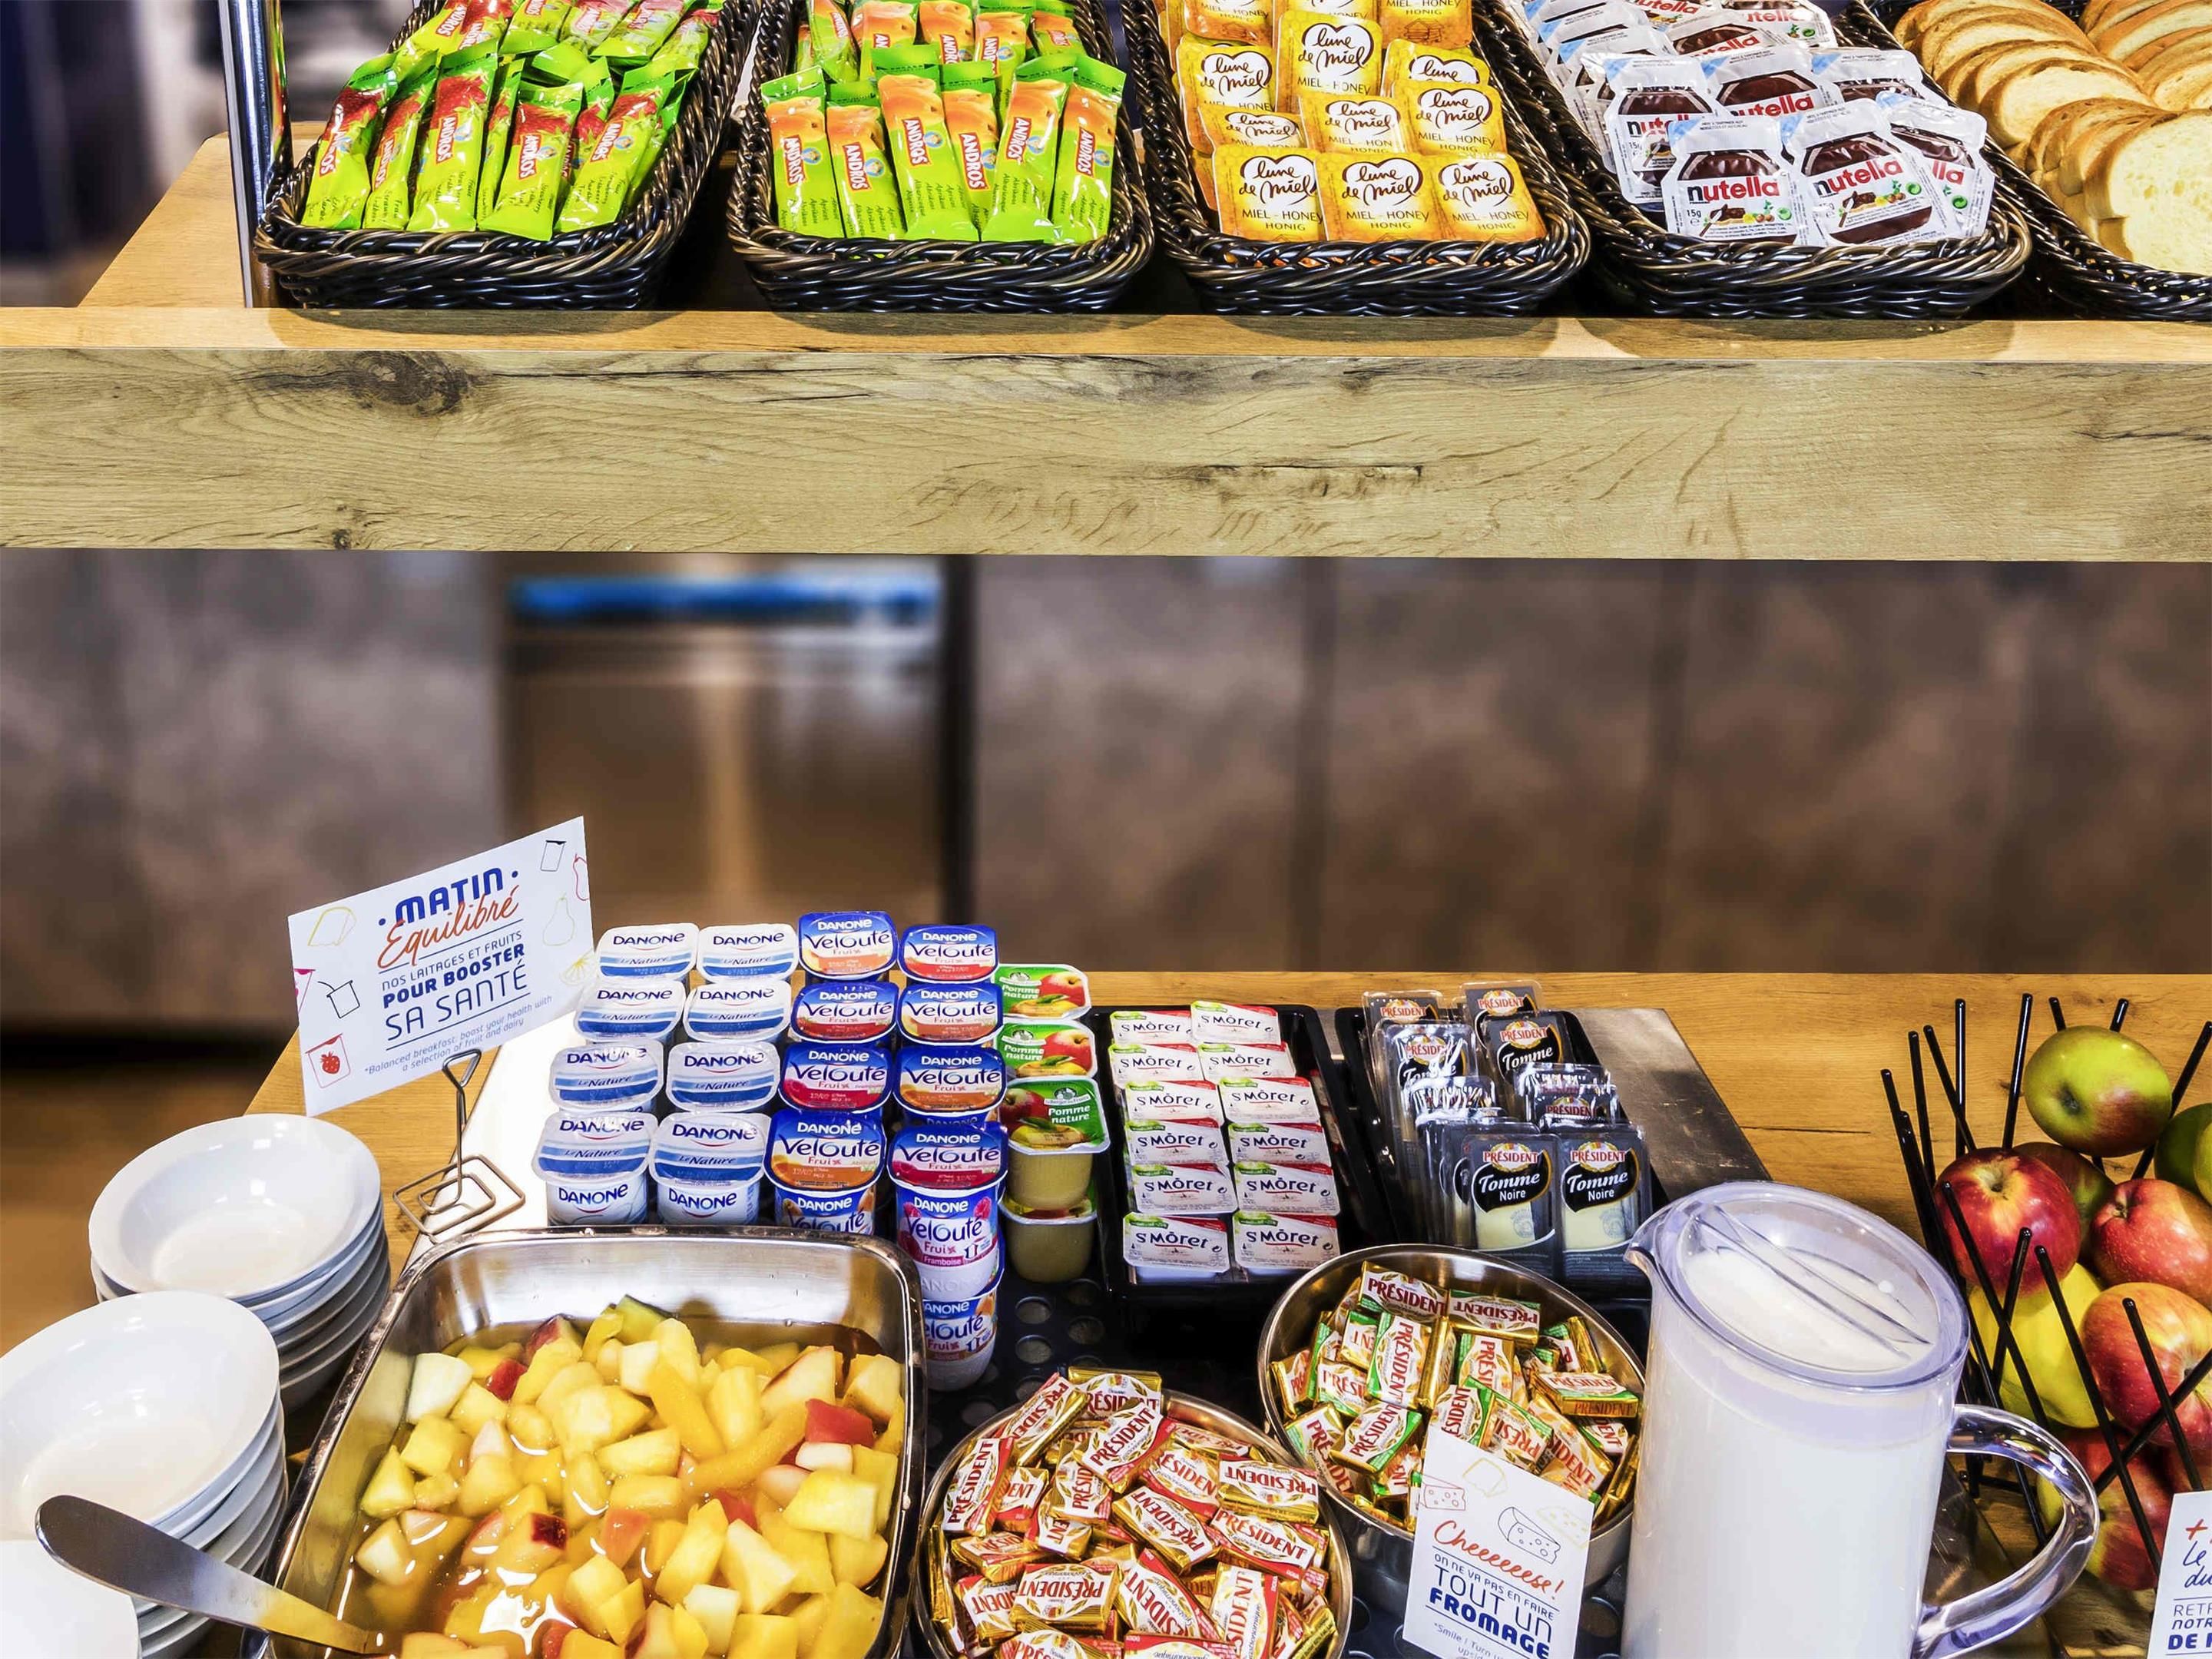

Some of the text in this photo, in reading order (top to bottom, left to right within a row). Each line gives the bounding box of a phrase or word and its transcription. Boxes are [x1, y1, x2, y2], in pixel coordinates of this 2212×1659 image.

[1313, 29, 1356, 48] lune
[1298, 47, 1367, 73] de miel
[1297, 78, 1321, 88] MIEL
[1429, 92, 1474, 108] lune
[1435, 105, 1488, 129] miel
[438, 117, 455, 162] ANDROS
[592, 123, 621, 161] ANDROS
[905, 120, 928, 164] ANDROS
[1008, 118, 1029, 160] ANDROS
[1419, 132, 1495, 148] MIEL HONEY
[1440, 144, 1478, 152] HONIG
[520, 135, 538, 177] ANDROS
[784, 137, 803, 184] ANDROS
[962, 134, 985, 188] ANDROS
[1078, 131, 1093, 174] ANDROS
[845, 145, 868, 189] ANDROS
[1253, 161, 1301, 178] lune
[1356, 166, 1402, 182] lune
[1452, 168, 1495, 184] lune
[1813, 160, 1904, 196] nutella
[1239, 174, 1314, 204] de miel
[1342, 176, 1419, 206] de miel
[1443, 178, 1513, 207] de miel
[1687, 176, 1780, 201] nutella
[1242, 209, 1323, 224] MIEL HONEY
[1346, 210, 1429, 222] MIEL HONEY
[1452, 210, 1528, 221] MIEL HONEY
[1687, 209, 1701, 217] 15g
[395, 867, 503, 927] MATIN
[803, 930, 890, 949] Velouté
[382, 930, 522, 991] NOS LAITAGES ET FRUITS
[383, 943, 525, 1008] POUR BOOSTER
[386, 959, 527, 1041] SA SANTÉ
[905, 1001, 995, 1017] Velouté
[1477, 997, 1525, 1009] PRÉSIDENT
[461, 1025, 483, 1040] boost
[486, 1016, 505, 1031] your
[507, 1005, 532, 1022] health
[535, 995, 552, 1009] with
[719, 1012, 759, 1021] Nature
[411, 1046, 451, 1069] selection
[465, 1033, 483, 1049] fruit
[485, 1025, 502, 1039] and
[503, 1017, 525, 1031] dairy
[1499, 1026, 1548, 1042] PRÉSIDENT
[1004, 1044, 1045, 1055] Pomme
[1005, 1051, 1043, 1061] nature
[1502, 1046, 1553, 1070] Tomme
[588, 1075, 632, 1088] Nature
[790, 1061, 886, 1082] Velouté
[906, 1068, 1001, 1084] Velouté
[705, 1080, 749, 1091] Nature
[1048, 1105, 1091, 1116] Pomme
[1051, 1113, 1090, 1124] nature
[575, 1148, 623, 1158] Nature
[778, 1134, 879, 1157] Velouté
[899, 1146, 1000, 1164] Velouté
[1484, 1150, 1538, 1164] PRÉSIDENT
[1571, 1149, 1626, 1162] PRÉSIDENT
[689, 1156, 734, 1165] Nature
[1479, 1173, 1541, 1193] Tomme
[1567, 1171, 1628, 1193] Tomme
[1499, 1189, 1526, 1202] Noire
[1588, 1189, 1614, 1202] Noire
[906, 1216, 982, 1243] Velouté
[923, 1256, 962, 1266] Framboise
[1368, 1277, 1446, 1316] PRÉSIDENT
[1454, 1300, 1538, 1324] PRÉSIDENT
[923, 1312, 983, 1340] elouté
[1389, 1321, 1414, 1402] PRÉSIDENT
[1012, 1382, 1069, 1439] PRÉSIDEN
[1441, 1386, 1471, 1436] ÉSIDENT
[1089, 1408, 1155, 1466] PRÉSIDENT
[1349, 1402, 1402, 1457] PRÉSIDENT
[948, 1442, 994, 1523] PRÉSIDENT
[1226, 1466, 1317, 1496] PRÉSIDENT
[1131, 1492, 1204, 1551] PRÉSIDENT
[1216, 1510, 1307, 1564] PRÉSIDENT
[1018, 1578, 1104, 1601] PRÉSIDENT
[1435, 1554, 1554, 1621] ON NE VA PAS EN FAIRE
[1434, 1564, 1551, 1643] TOUT UN
[1429, 1587, 1550, 1659] FROMAGE
[2167, 1633, 2198, 1650] DE
